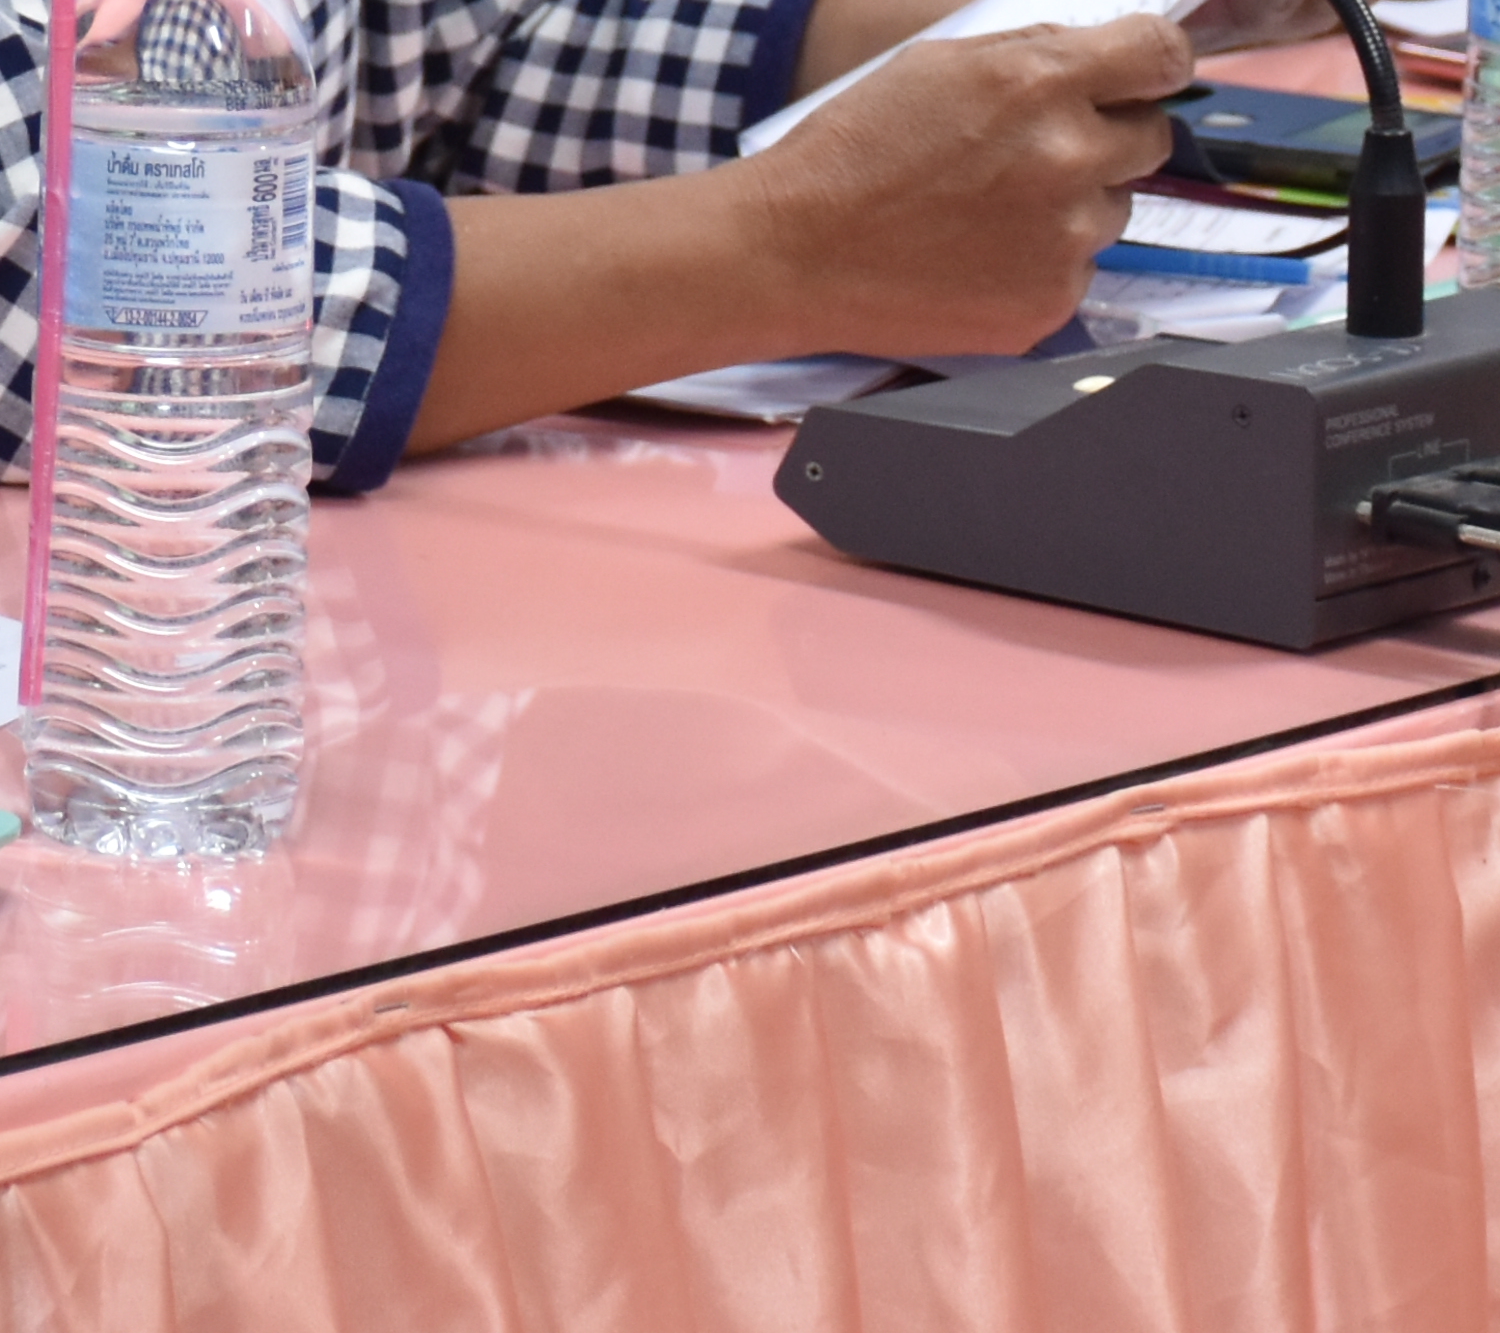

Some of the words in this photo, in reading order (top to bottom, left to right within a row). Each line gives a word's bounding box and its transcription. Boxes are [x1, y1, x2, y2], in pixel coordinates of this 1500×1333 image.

[144, 157, 205, 179] ตราเทสโก้
[252, 173, 279, 203] 600
